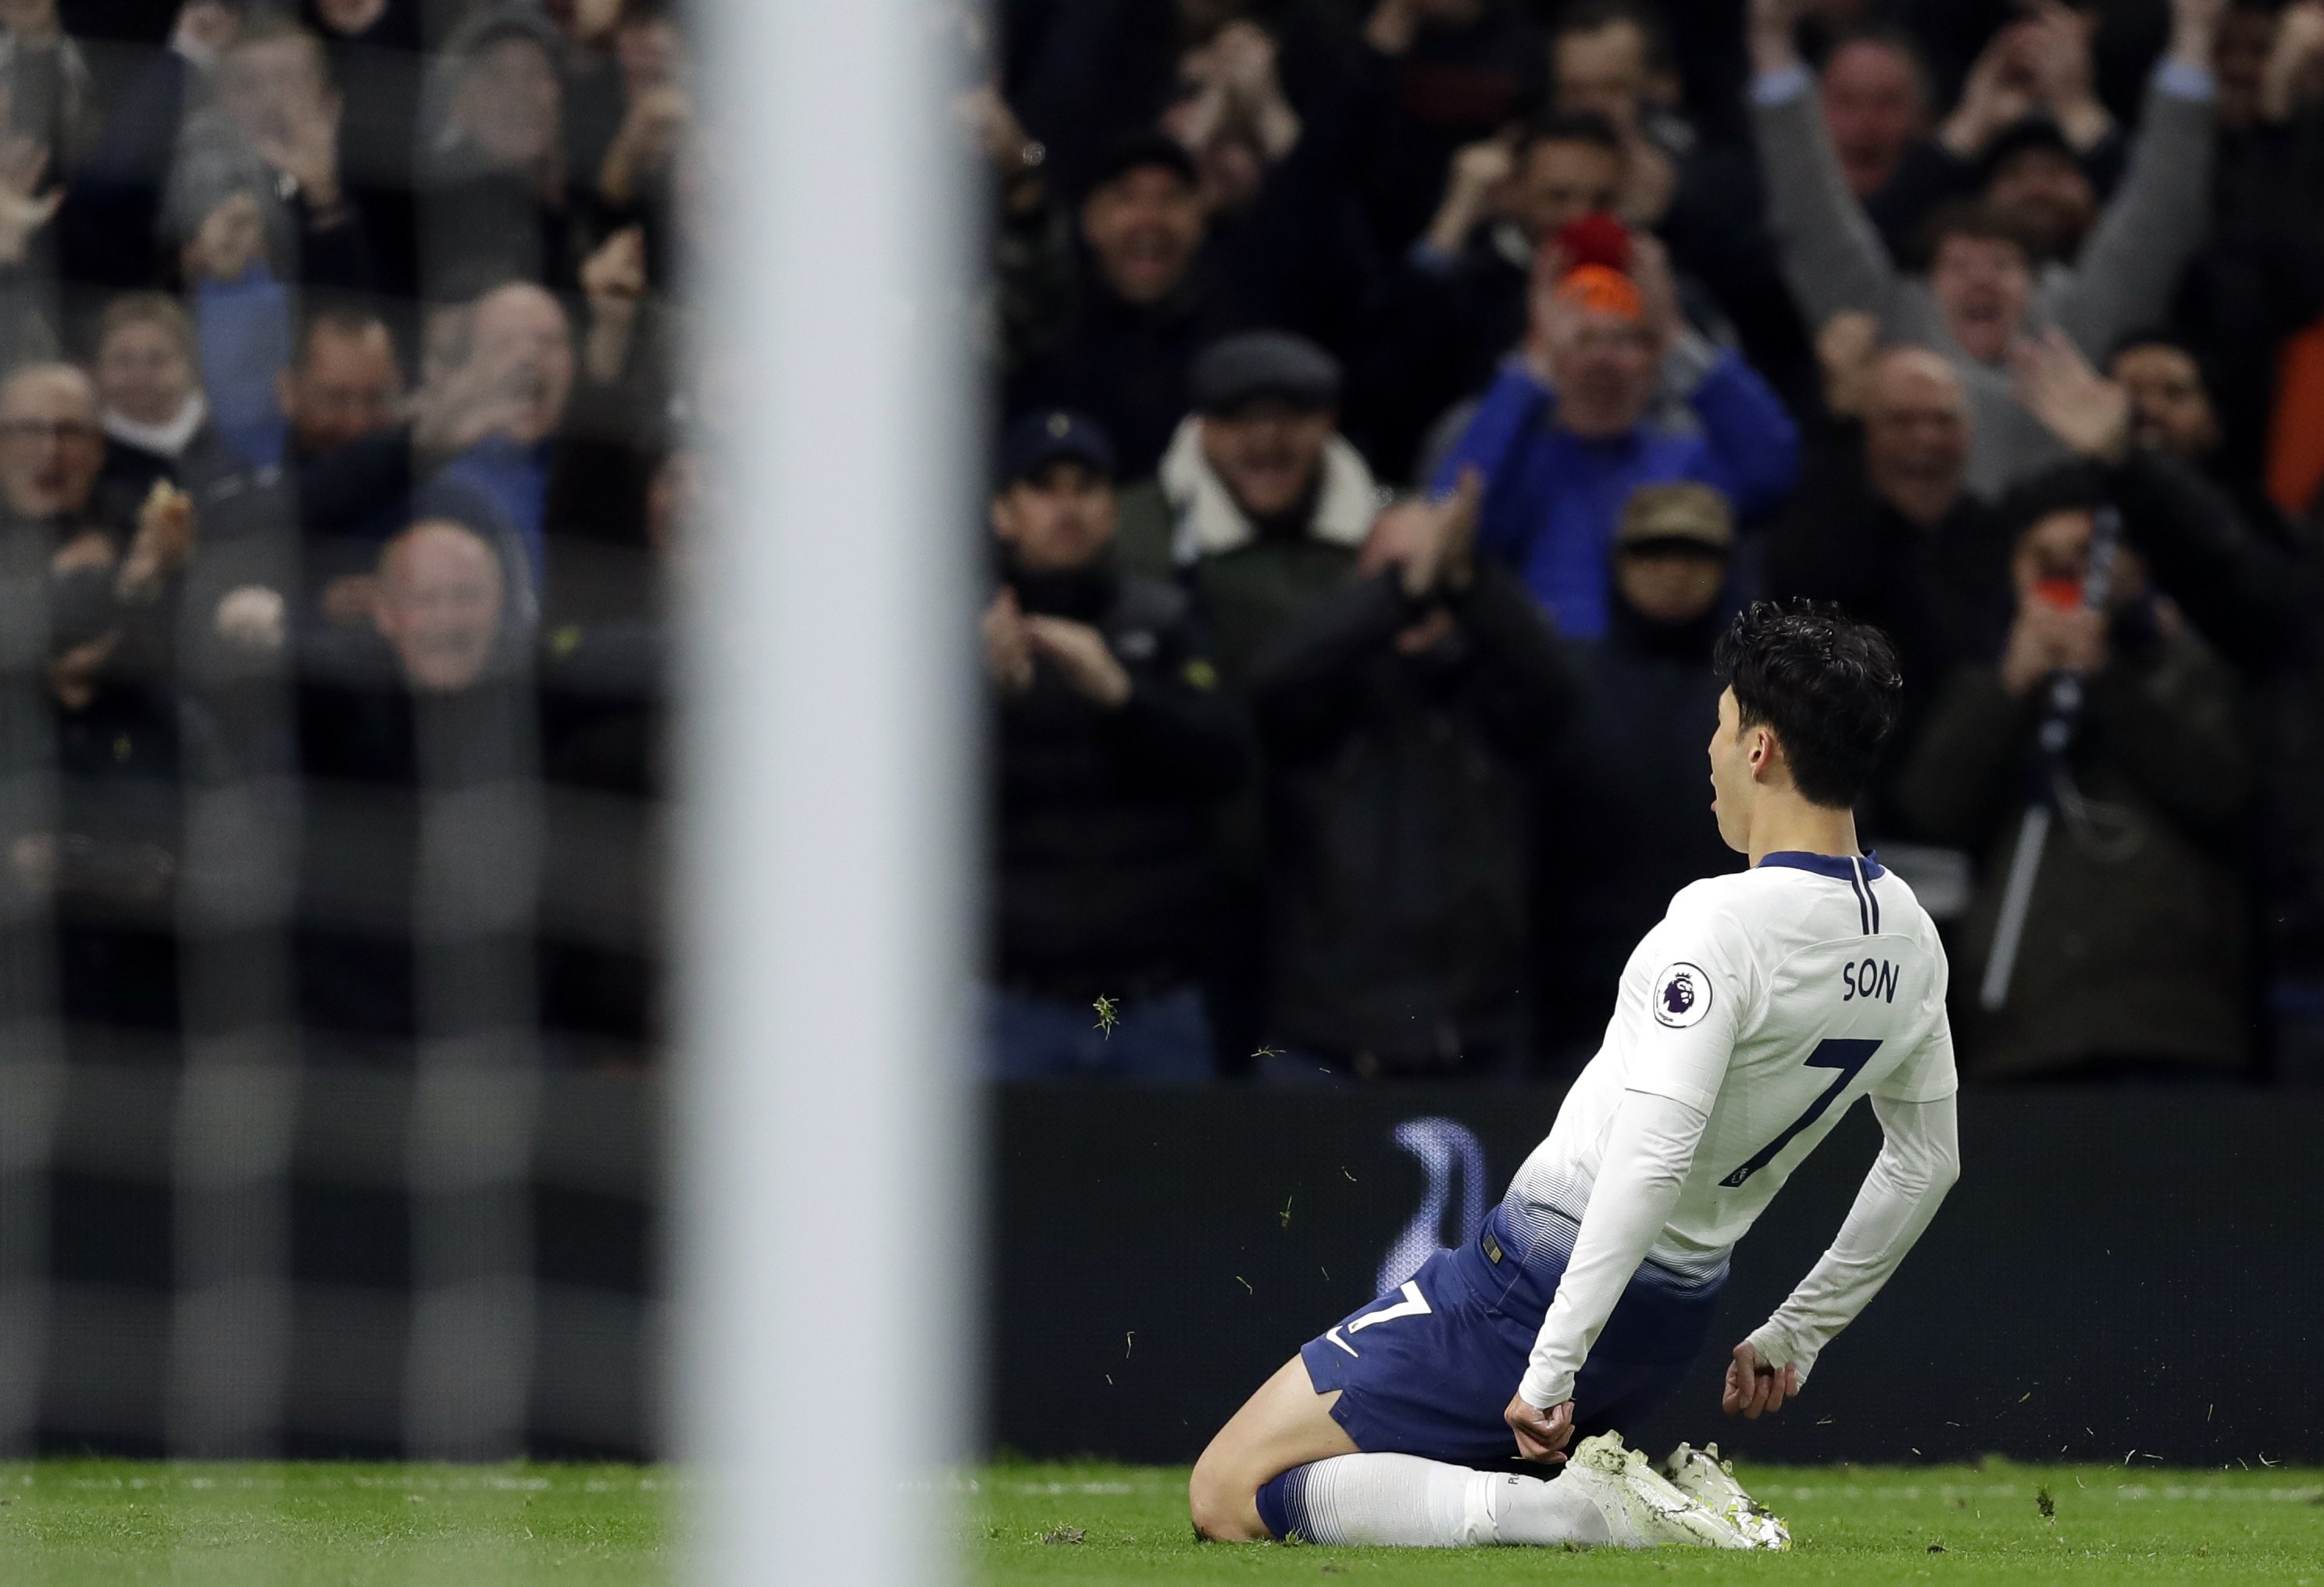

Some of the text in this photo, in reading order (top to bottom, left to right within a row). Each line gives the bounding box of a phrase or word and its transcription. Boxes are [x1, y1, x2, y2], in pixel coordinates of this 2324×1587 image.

[1843, 958, 1900, 1004] SON
[1718, 1038, 1884, 1188] 7
[1348, 1279, 1433, 1334] 7
